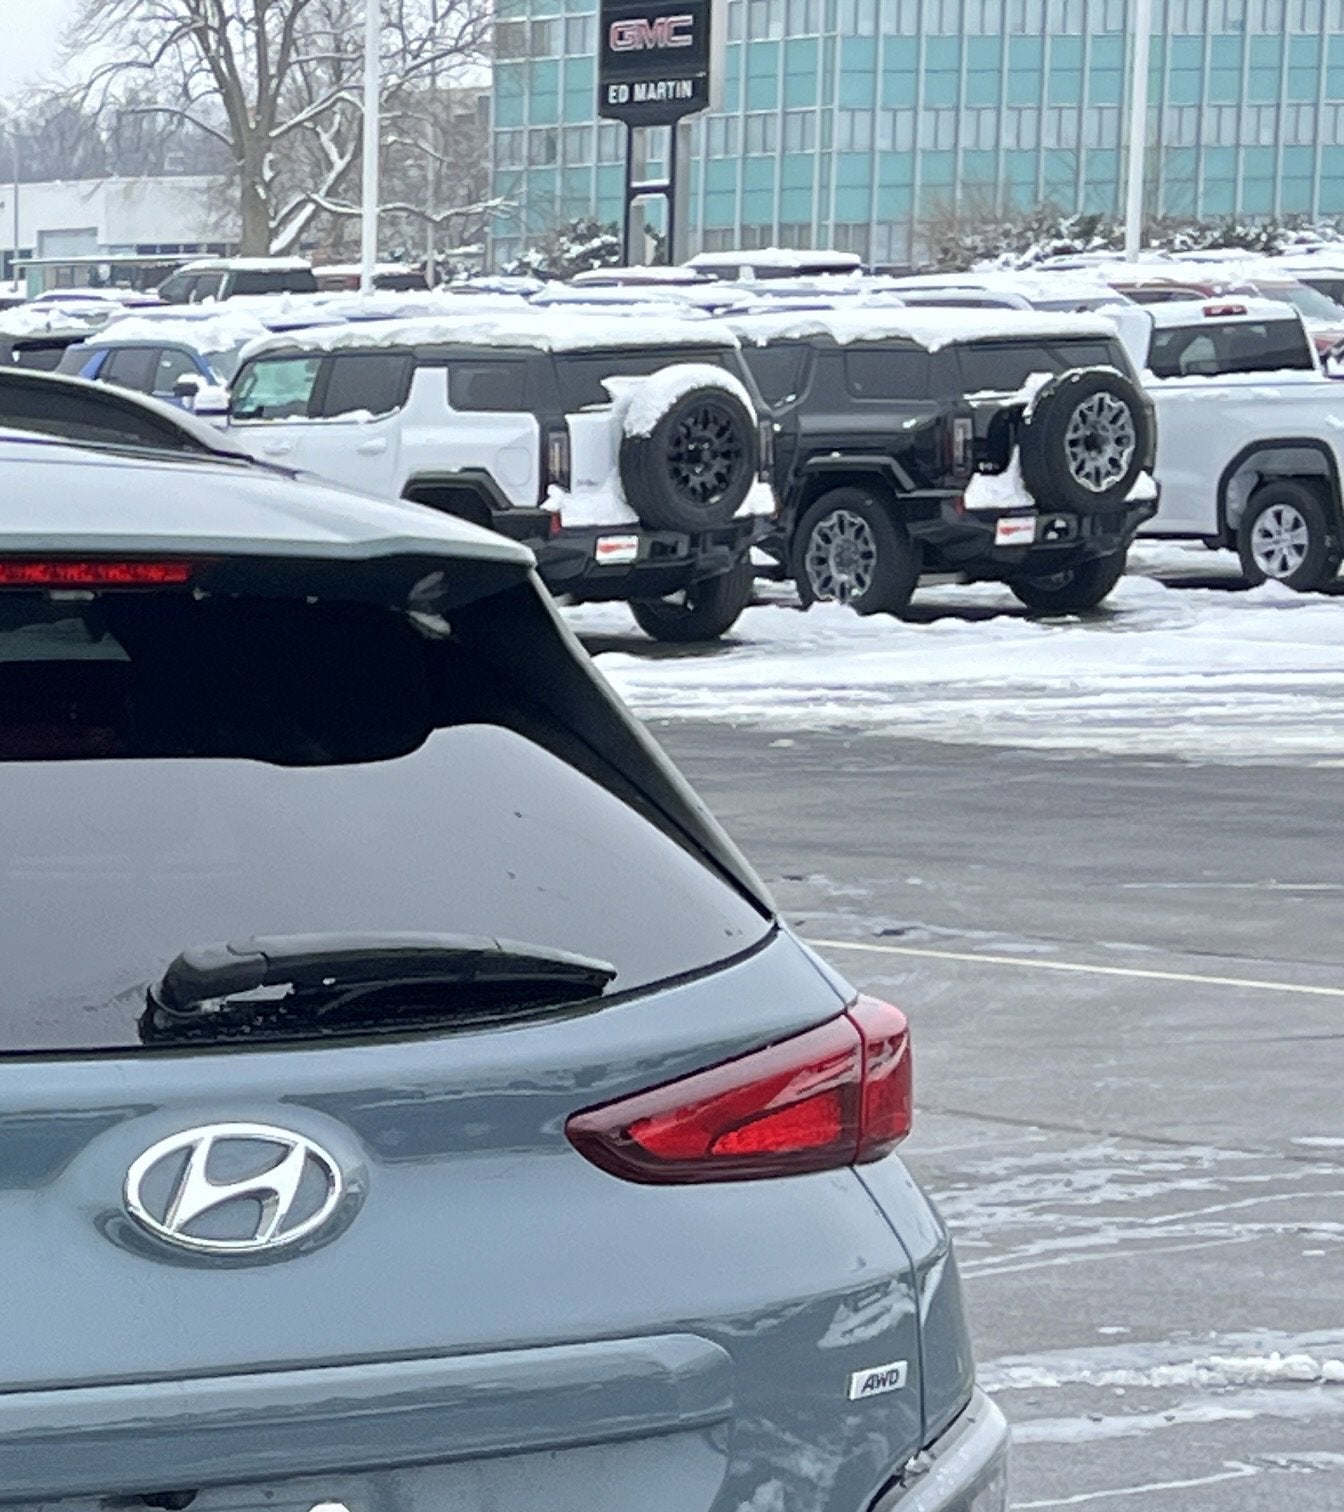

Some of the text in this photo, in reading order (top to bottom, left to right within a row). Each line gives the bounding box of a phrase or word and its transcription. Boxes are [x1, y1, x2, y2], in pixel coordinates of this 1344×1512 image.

[610, 15, 693, 51] GMC
[608, 80, 693, 103] ED MARTIN
[860, 1368, 900, 1395] AWD
